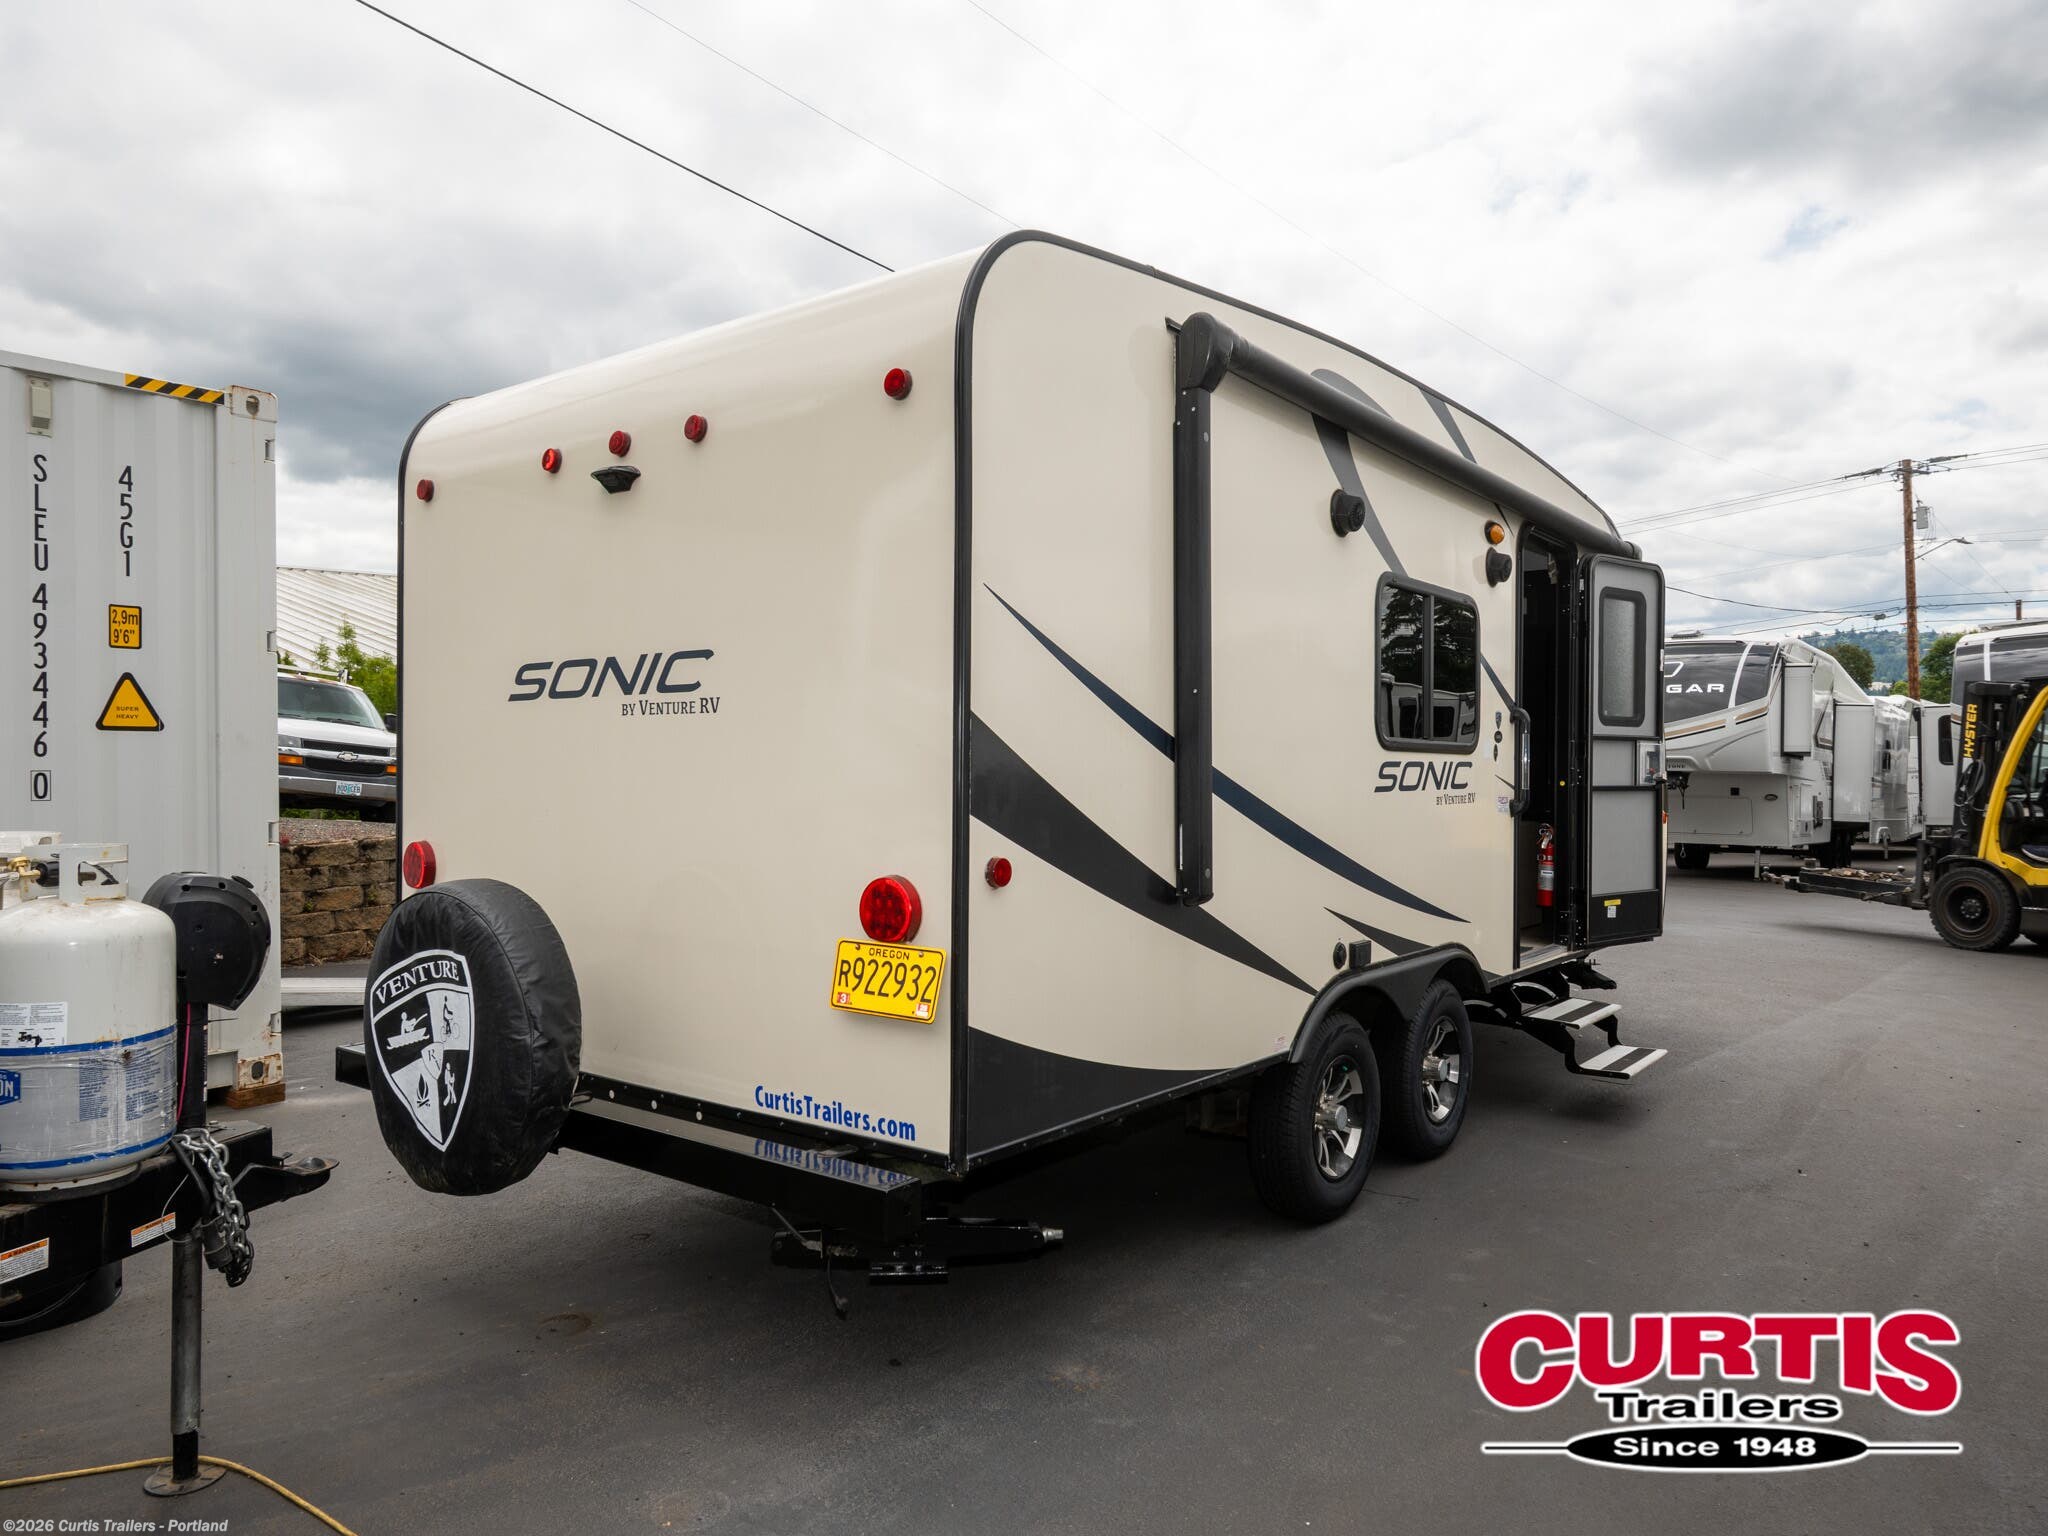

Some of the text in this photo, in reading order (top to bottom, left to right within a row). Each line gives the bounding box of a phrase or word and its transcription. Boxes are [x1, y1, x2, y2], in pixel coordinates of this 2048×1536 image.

[118, 465, 134, 577] 45G1
[32, 453, 49, 800] SLEU 493446 0
[508, 648, 715, 702] SONIC
[621, 702, 636, 716] BY
[698, 697, 721, 714] RV
[1963, 703, 1978, 758] HYSTER
[1373, 761, 1473, 793] SONIC
[1467, 792, 1476, 804] RV
[868, 947, 910, 960] OREGON
[376, 960, 460, 1004] VENTURE
[837, 957, 937, 1004] R922932
[755, 1085, 916, 1142] CurtisTrailers.com
